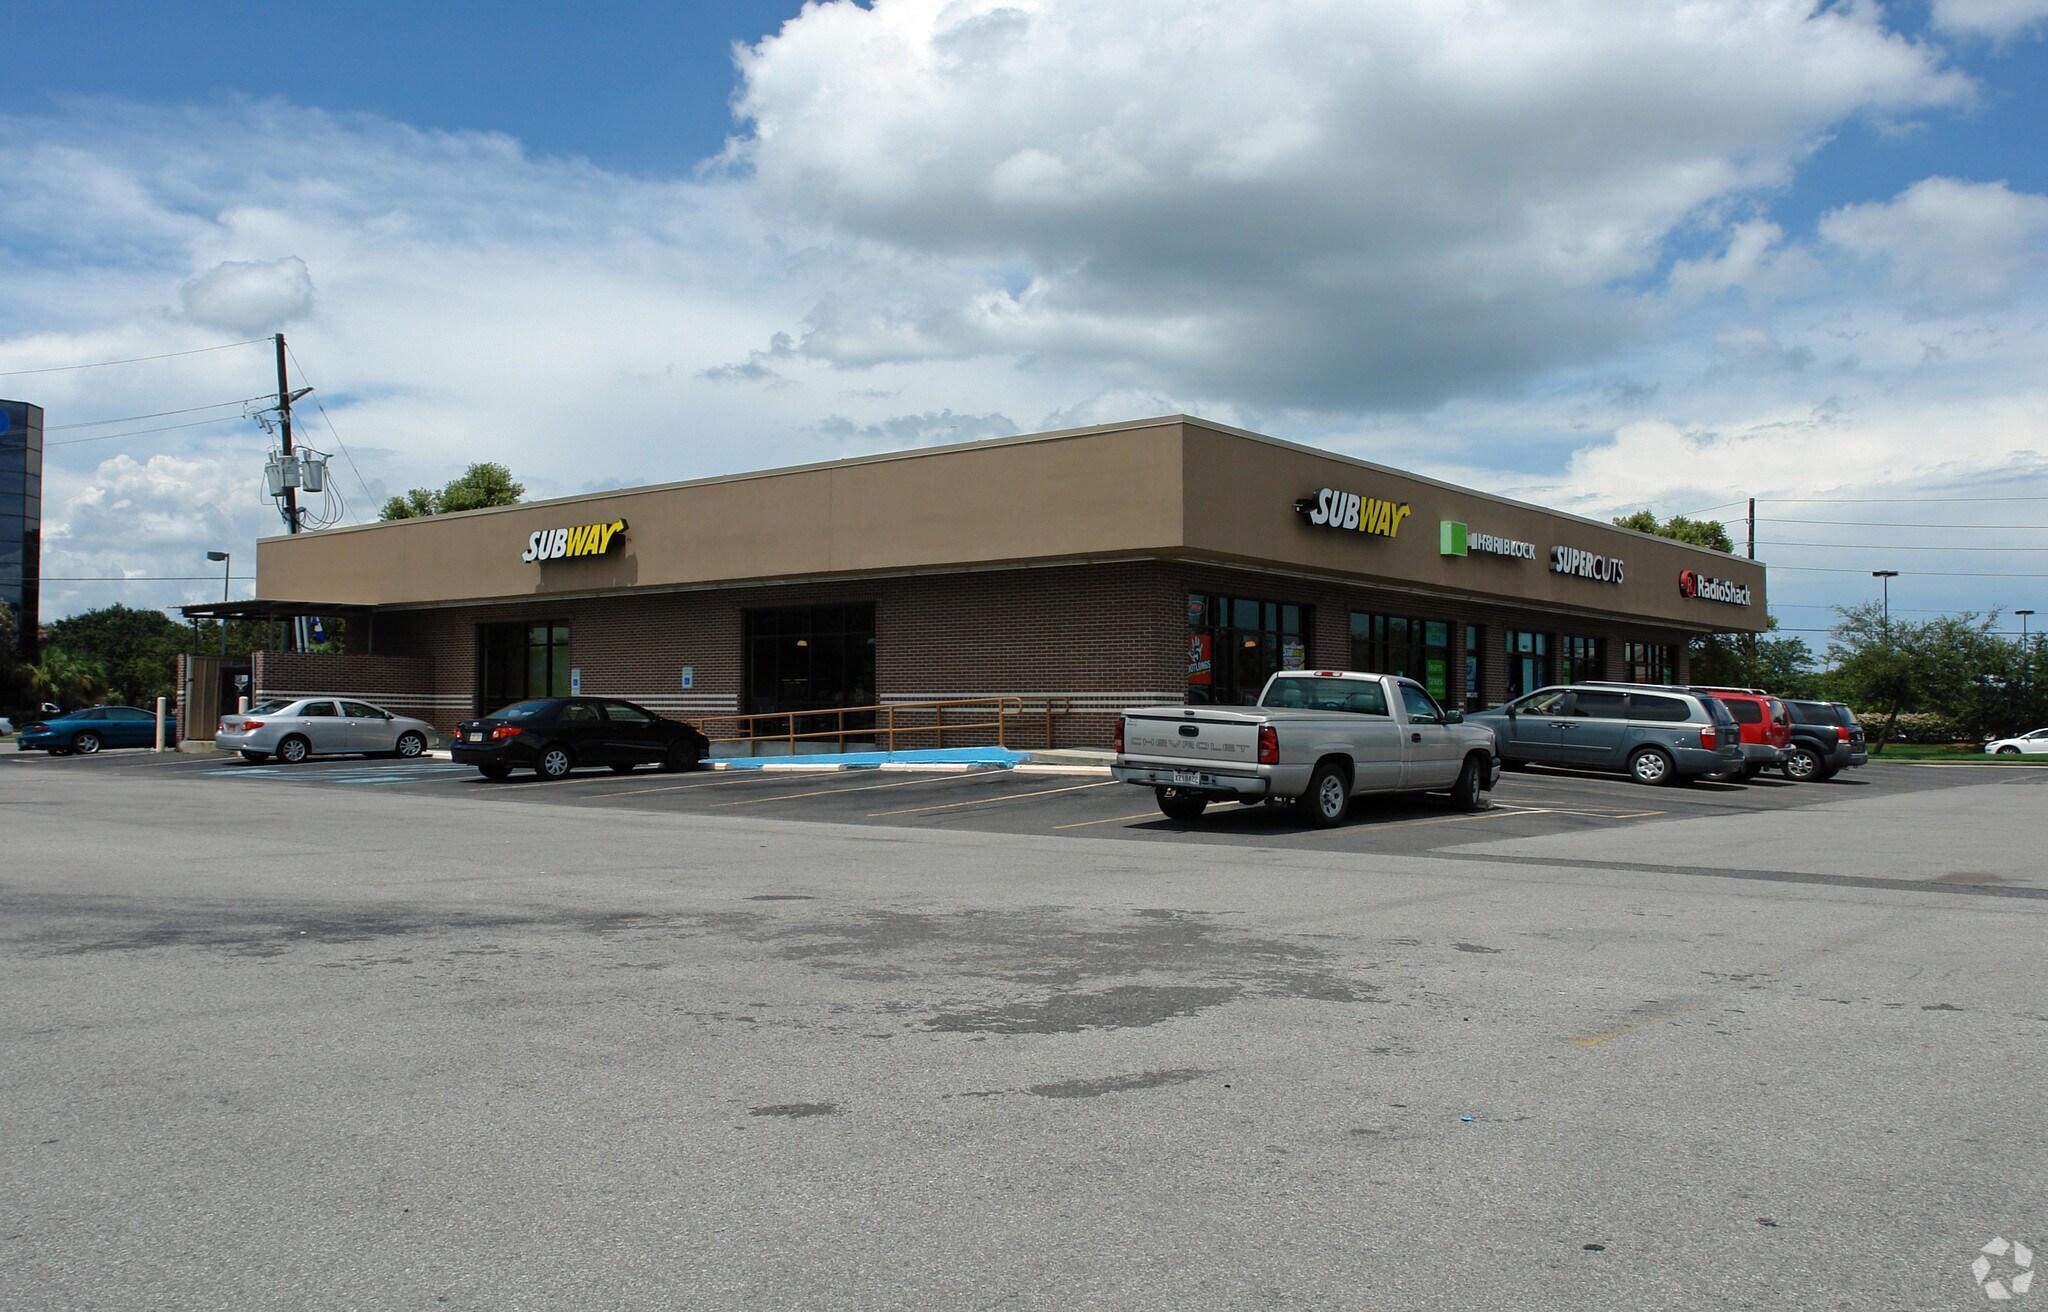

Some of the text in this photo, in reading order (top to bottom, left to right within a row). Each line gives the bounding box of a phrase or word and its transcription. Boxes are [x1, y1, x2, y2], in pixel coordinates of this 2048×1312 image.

[1310, 488, 1412, 537] SUBWAY
[522, 519, 624, 562] SUBWAY
[1477, 533, 1536, 560] H&R BLOCK
[1556, 545, 1624, 584] SUPERCUTS
[1698, 574, 1751, 606] RadioShack
[1130, 737, 1250, 753] CHEVROLET
